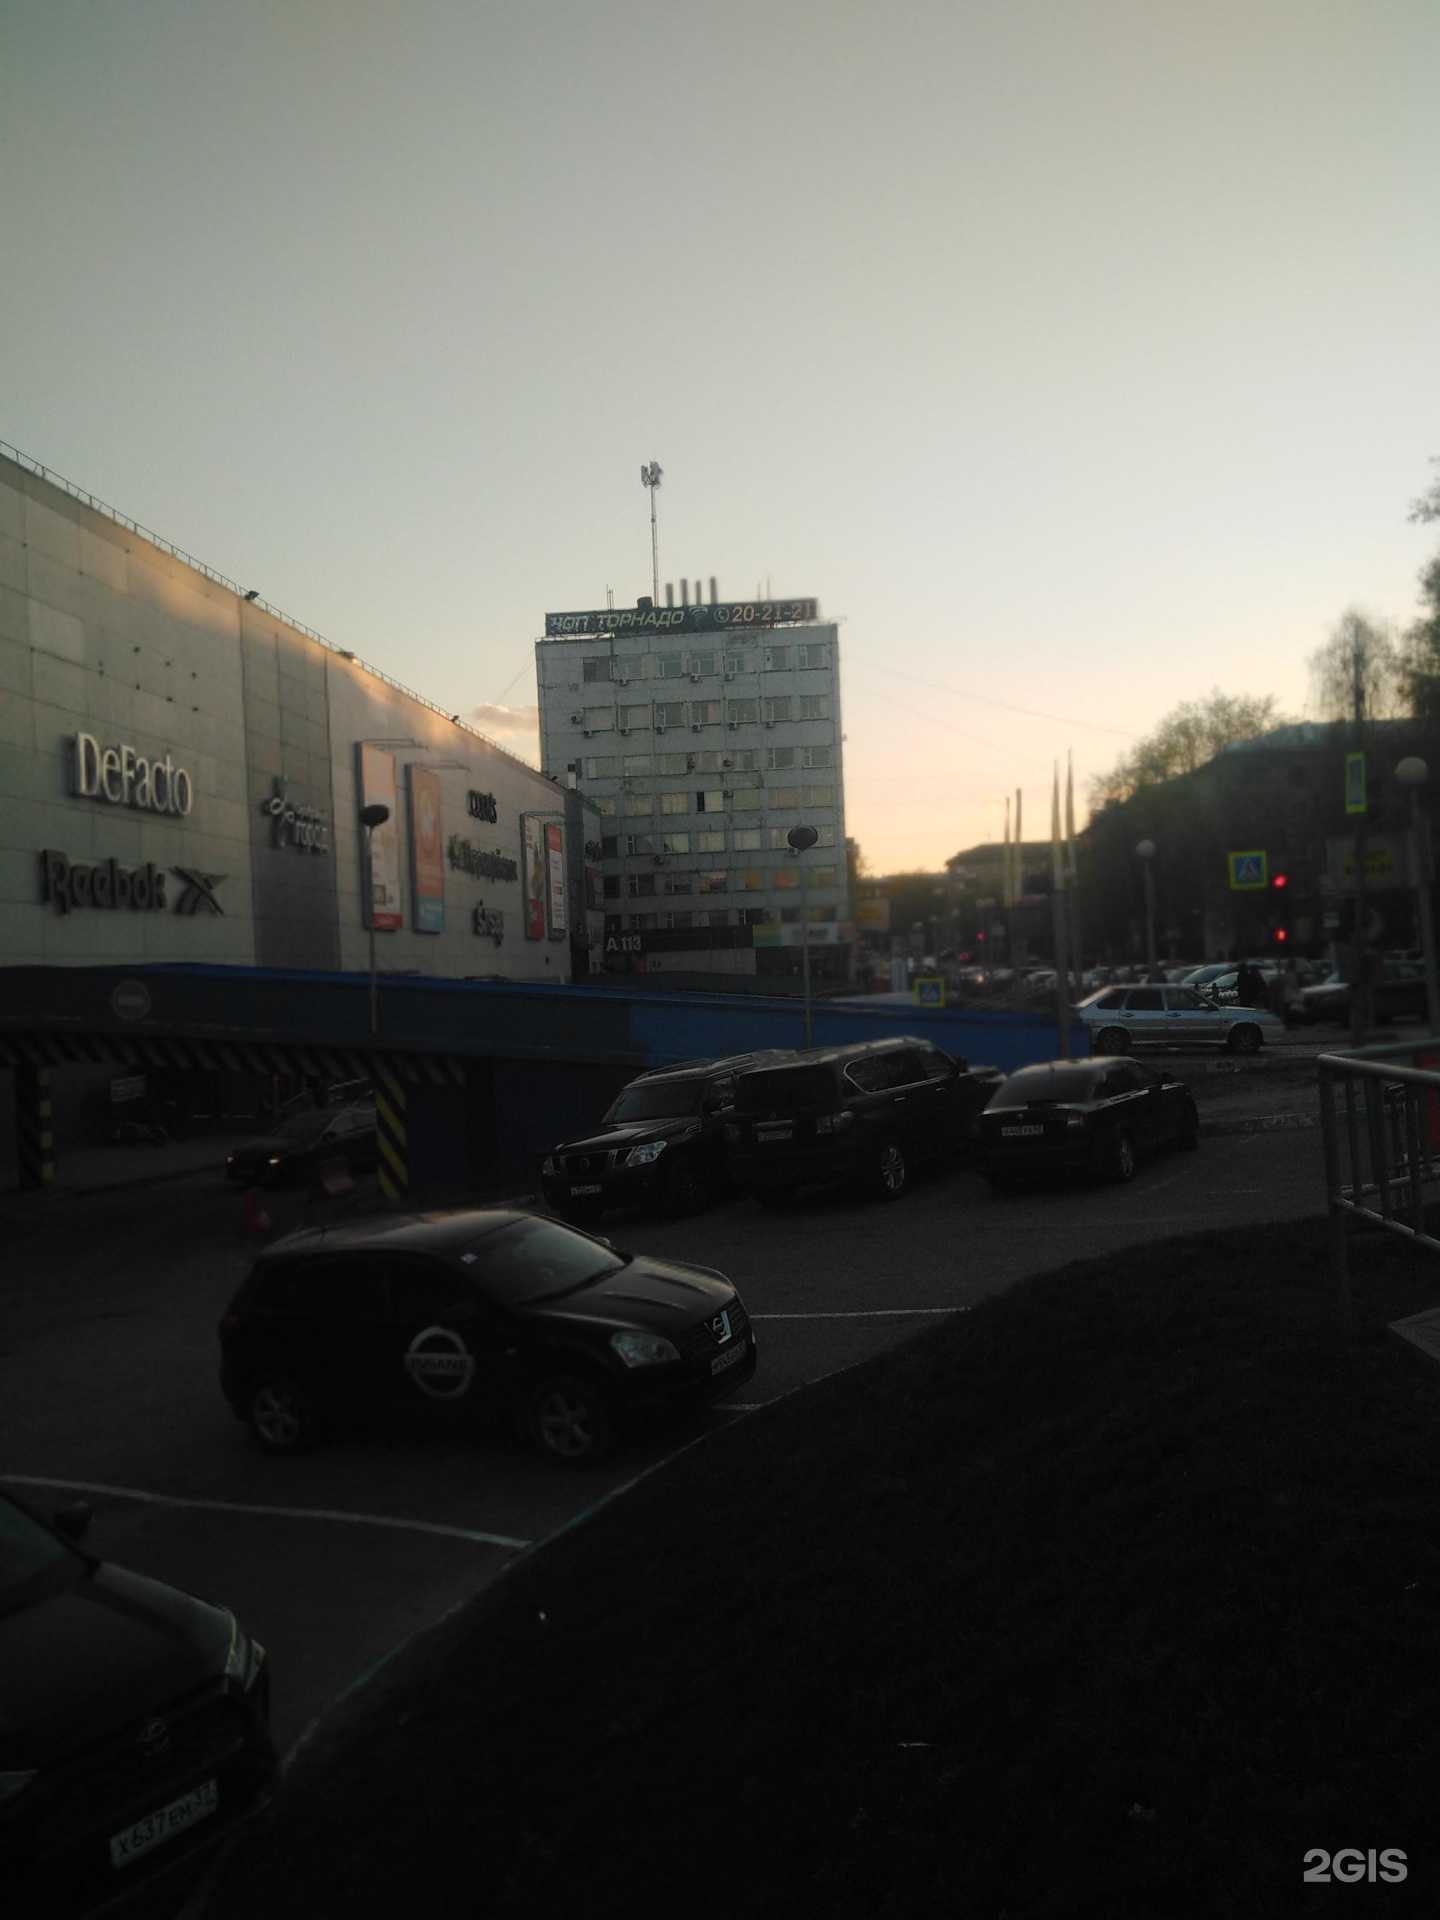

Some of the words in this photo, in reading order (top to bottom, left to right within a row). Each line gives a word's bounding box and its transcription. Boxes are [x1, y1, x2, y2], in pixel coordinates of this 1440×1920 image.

[549, 615, 590, 633] ЧОП
[597, 609, 685, 632] ТОРНАДО
[731, 602, 814, 624] 20-21-21
[75, 731, 193, 816] DeFacto
[40, 848, 167, 915] Reebok
